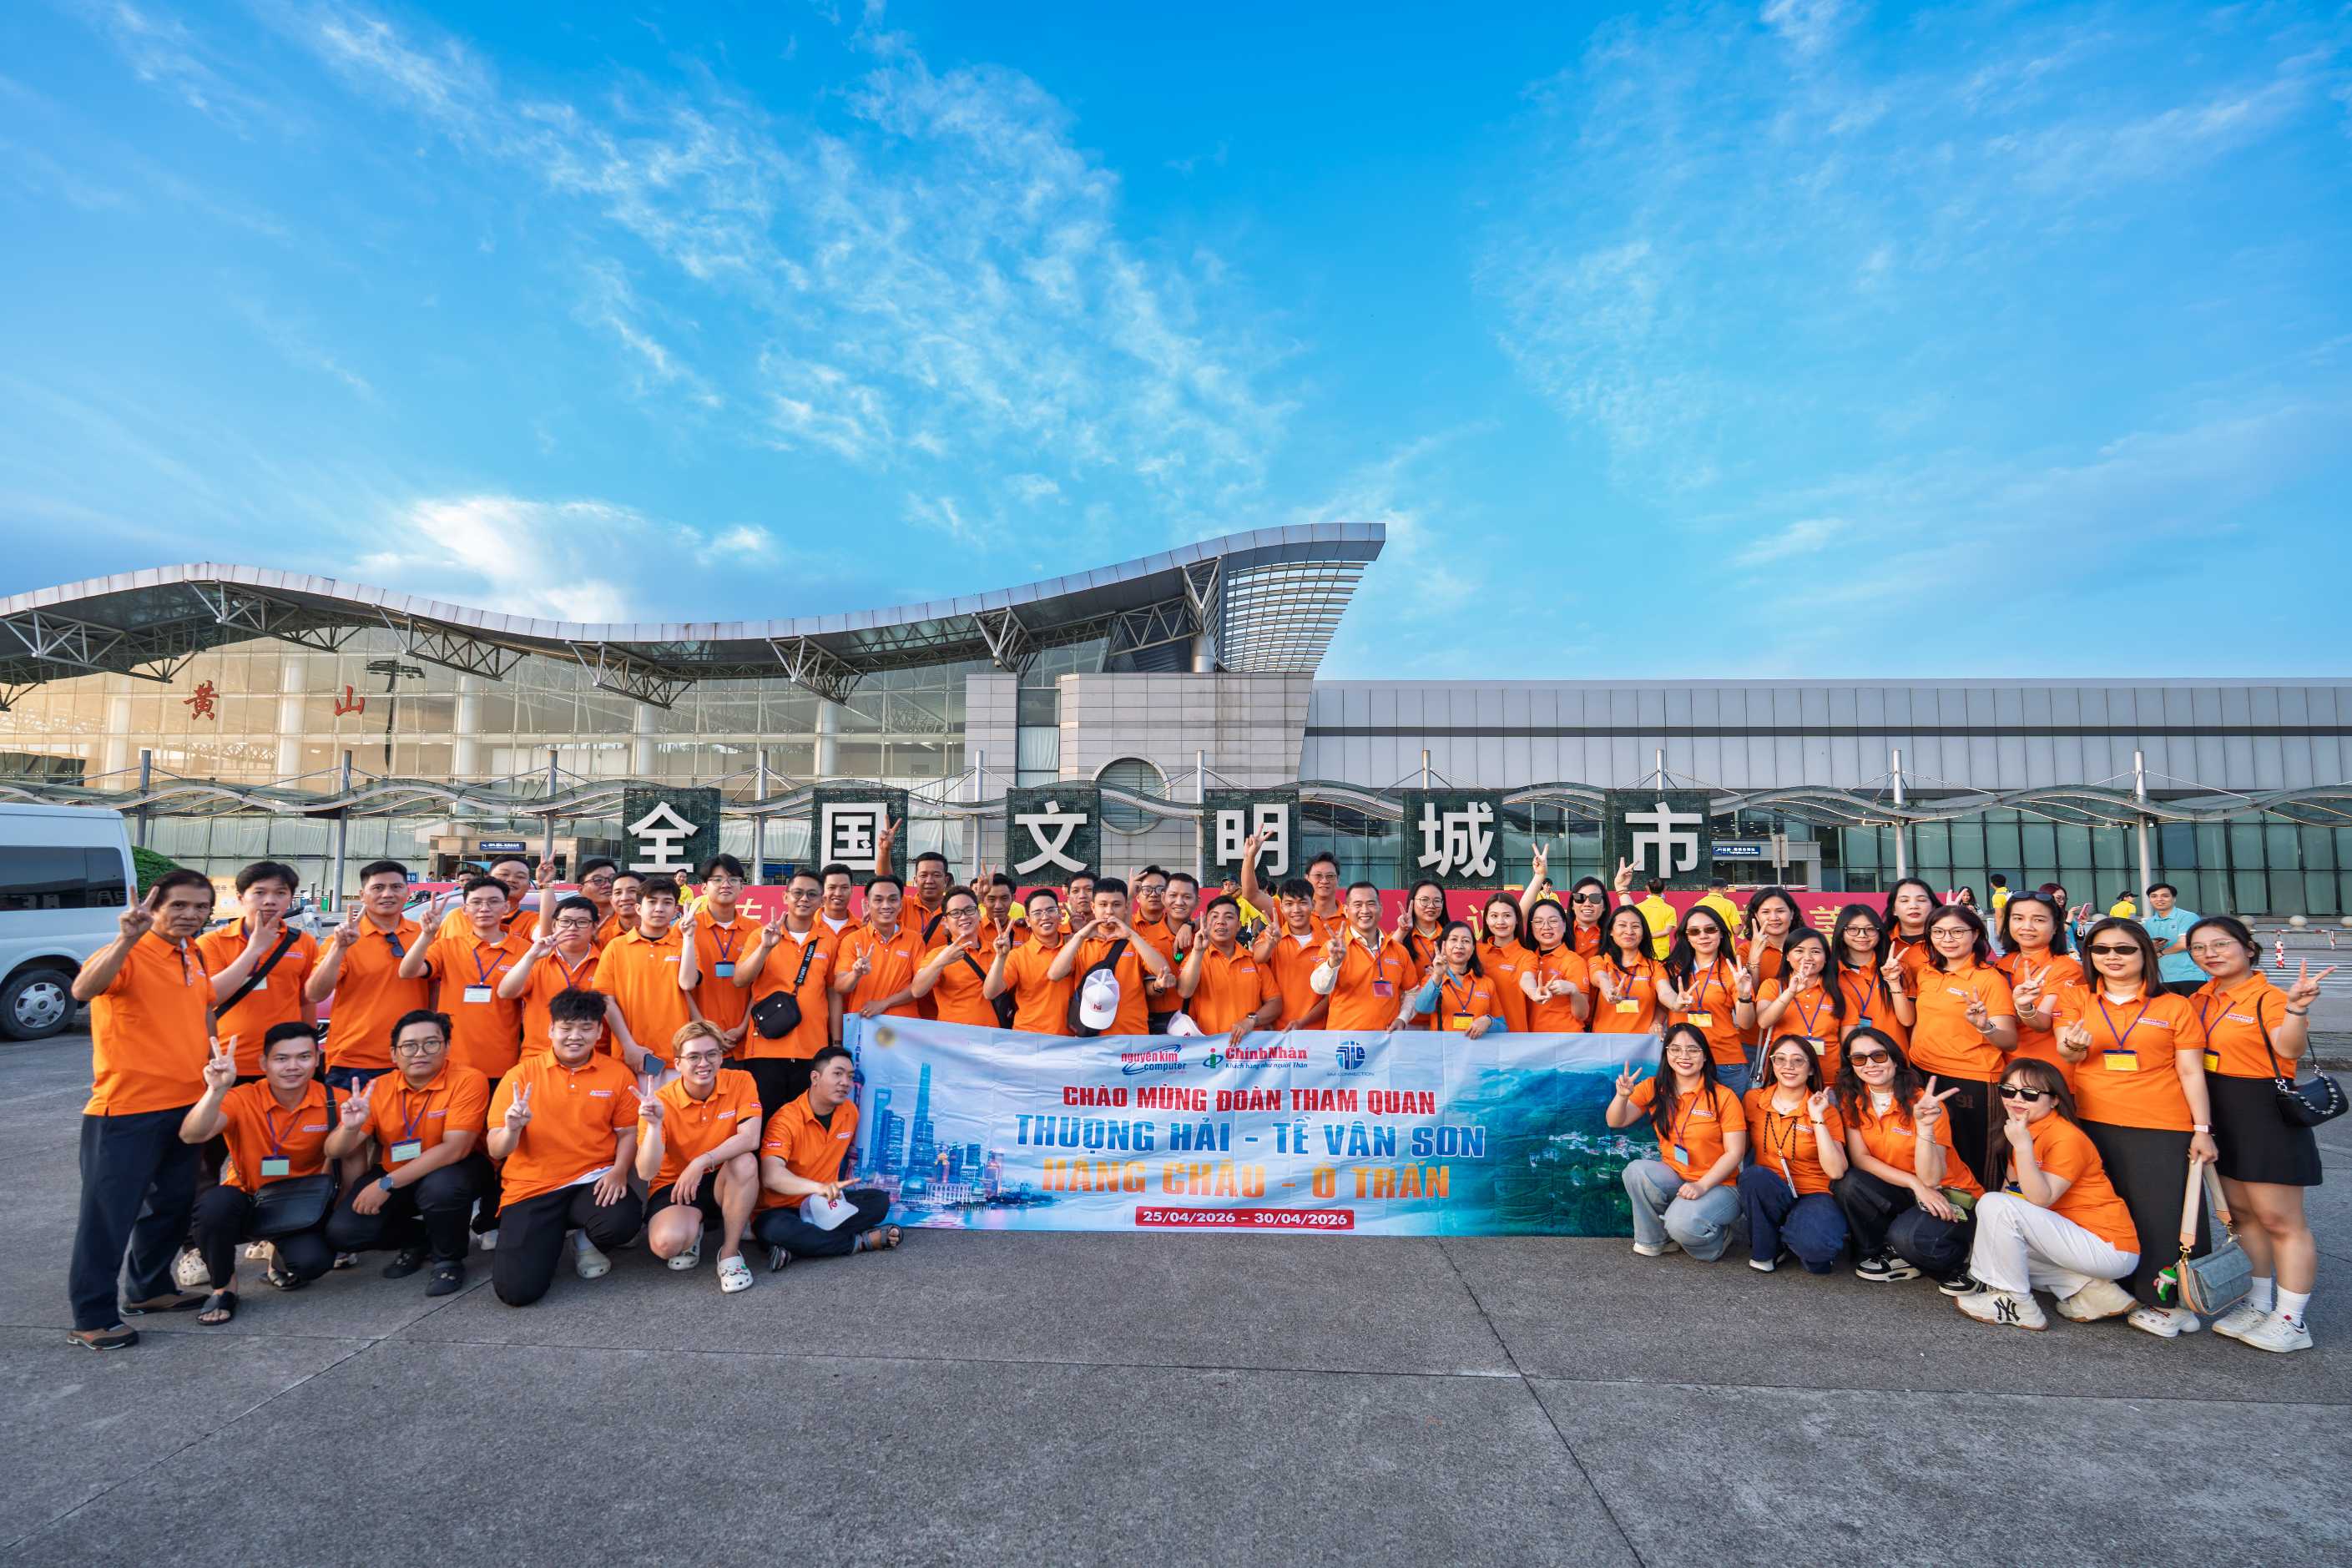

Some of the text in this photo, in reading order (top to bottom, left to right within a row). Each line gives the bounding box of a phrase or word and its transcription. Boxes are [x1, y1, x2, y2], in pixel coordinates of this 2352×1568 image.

[183, 679, 366, 721] 黄山
[627, 800, 1703, 879] 全国文明城市
[1143, 1062, 1188, 1071] computer
[1063, 1083, 1436, 1116] CHÀO MỪNG ĐOÀN THAM QUAN
[1015, 1114, 1155, 1154] THƯỢNG
[1169, 1117, 1230, 1151] HẢI
[1272, 1116, 1311, 1155] TỀ
[1323, 1121, 1396, 1157] VÂN
[1411, 1126, 1485, 1157] SƠN
[1162, 1158, 1265, 1198] CHÂU
[1311, 1162, 1336, 1199] Ô
[1351, 1161, 1450, 1199] TRẤN
[1142, 1211, 1236, 1223] 25/04/2026
[1254, 1213, 1348, 1226] 30/04/2026
